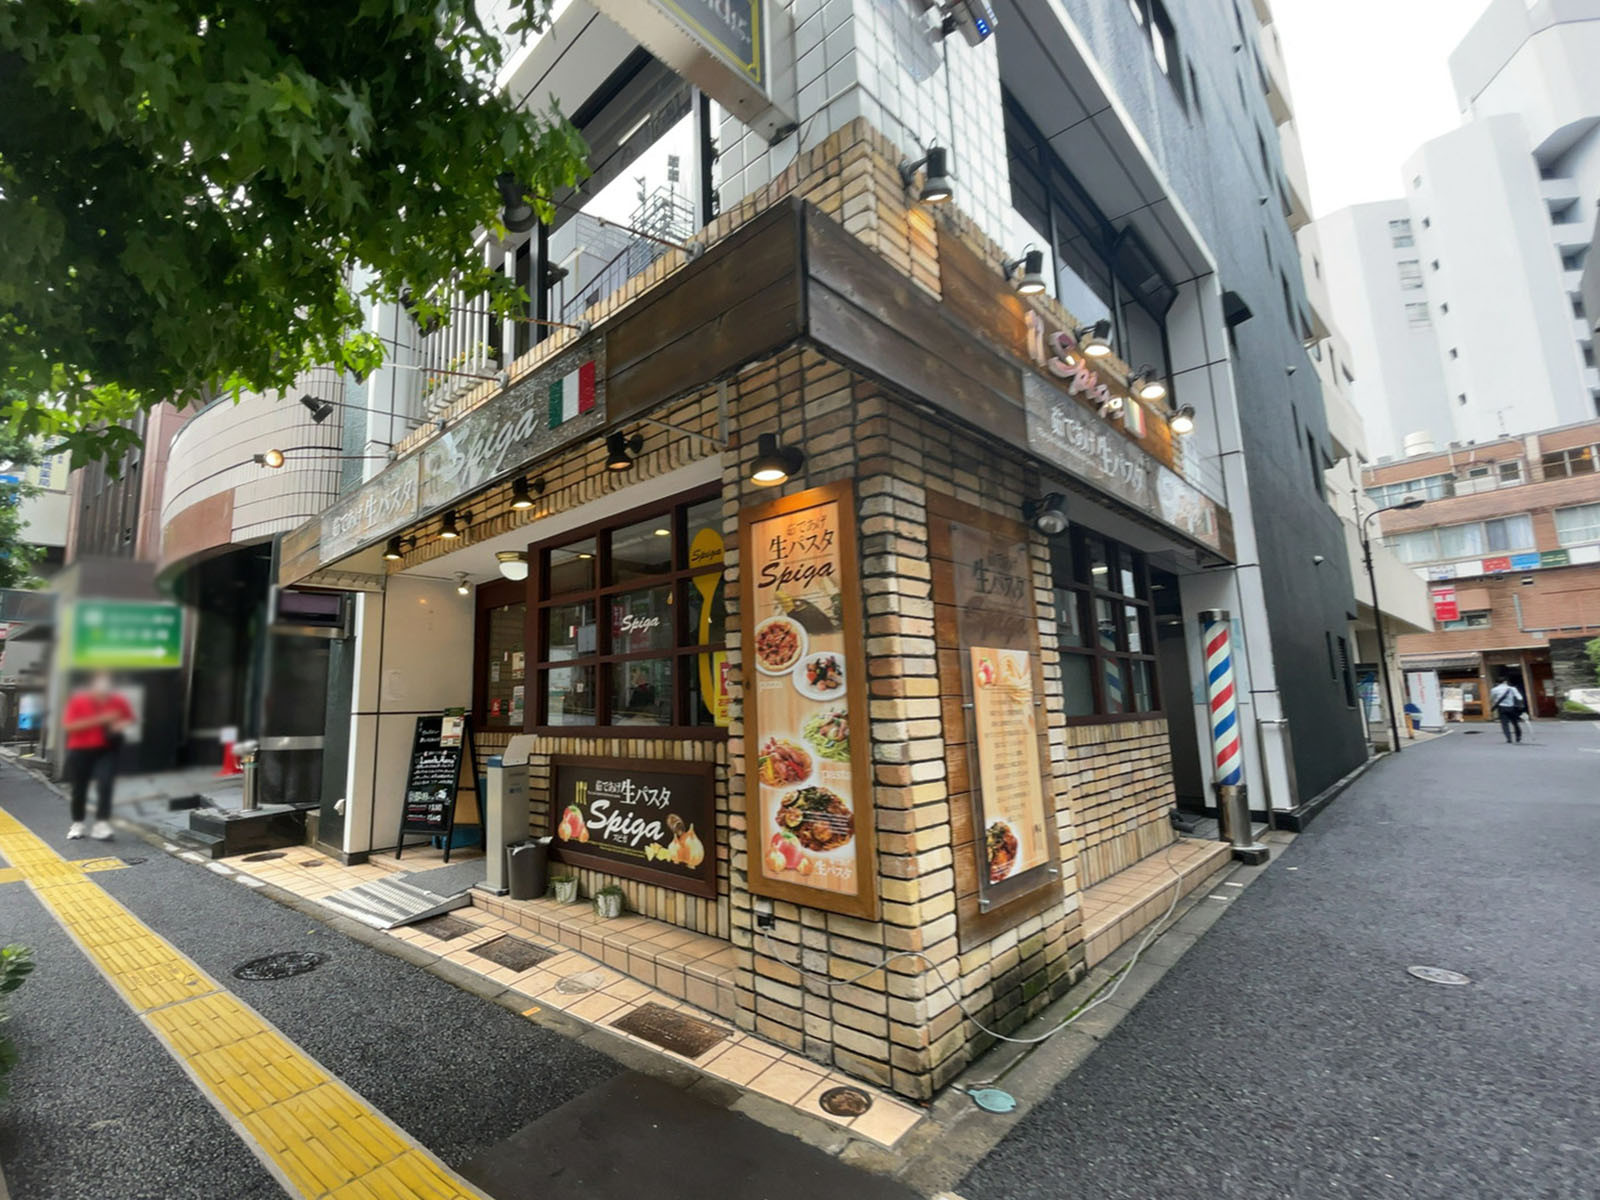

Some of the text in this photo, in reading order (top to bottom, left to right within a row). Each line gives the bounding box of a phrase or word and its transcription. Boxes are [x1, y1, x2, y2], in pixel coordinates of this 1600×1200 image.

[447, 407, 539, 484] Spiga
[691, 548, 723, 562] Spiga
[769, 528, 835, 562] 生パスタ
[757, 561, 837, 591] Spiga
[620, 614, 661, 635] Spiga
[586, 799, 665, 847] Spiga
